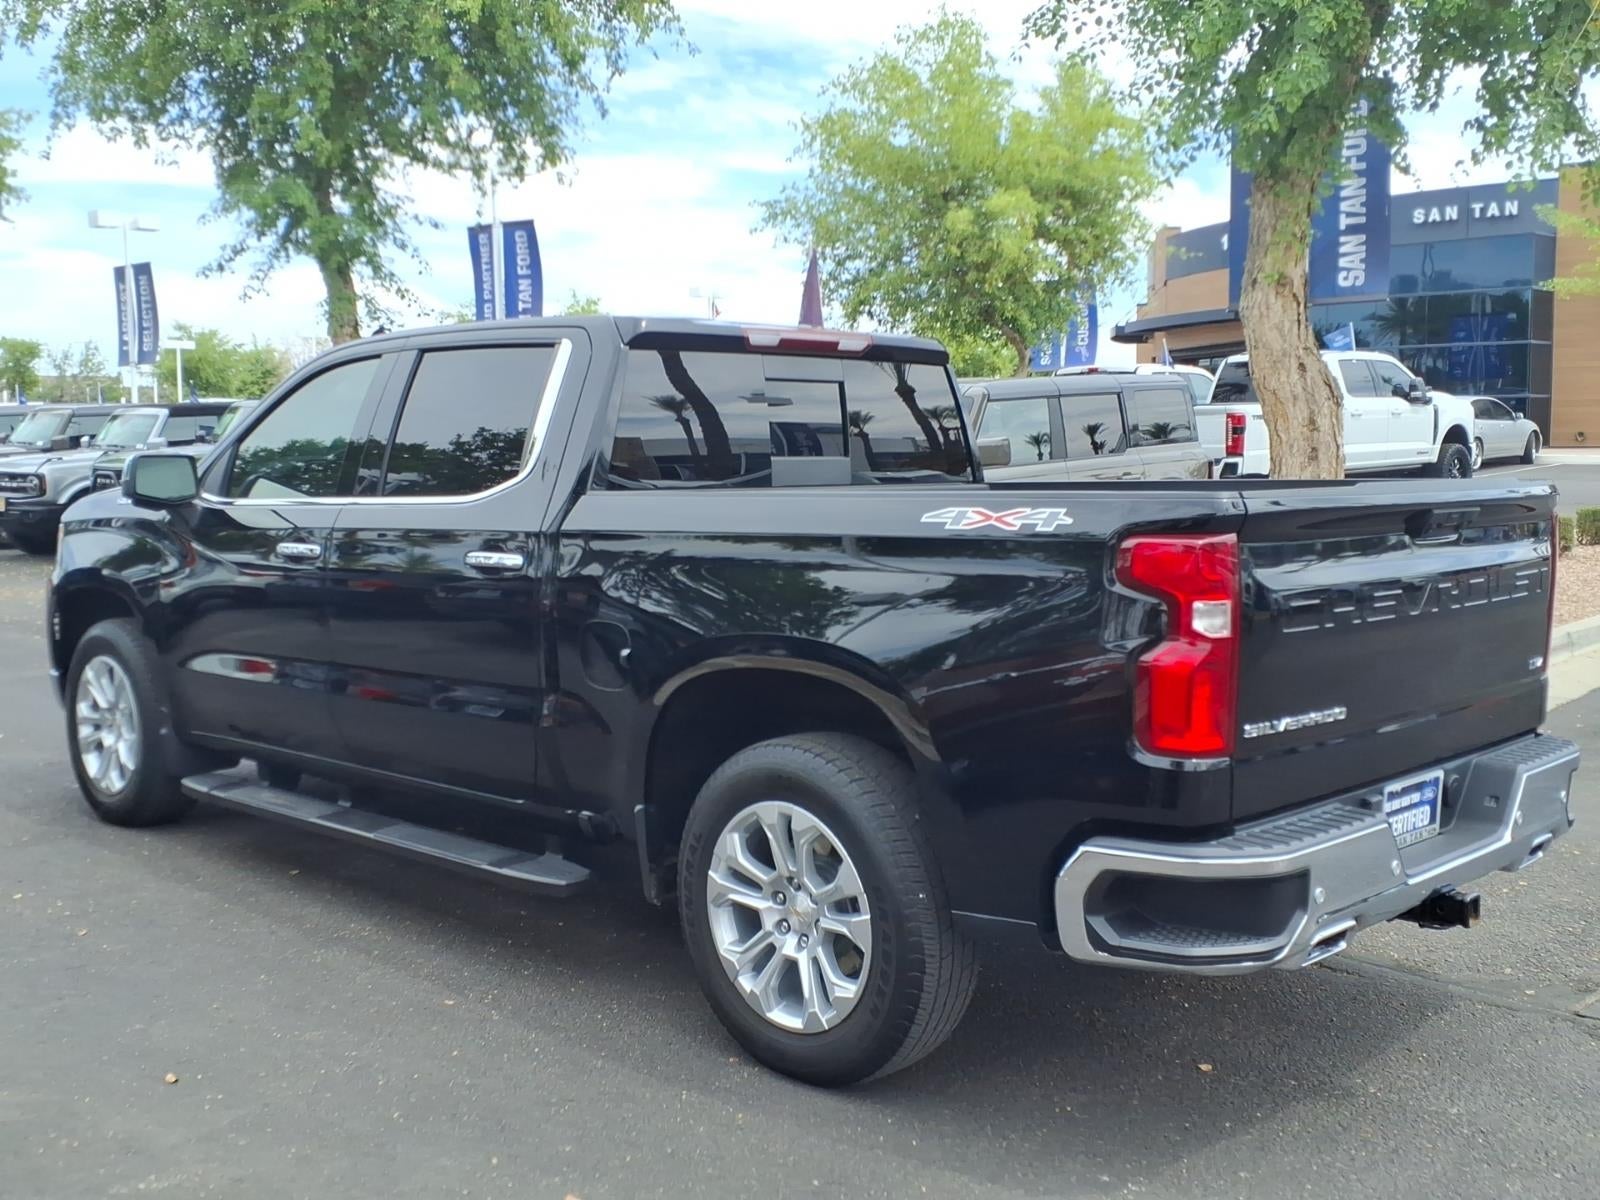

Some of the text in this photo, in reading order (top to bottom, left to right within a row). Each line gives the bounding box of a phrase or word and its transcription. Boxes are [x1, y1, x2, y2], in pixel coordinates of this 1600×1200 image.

[1339, 177, 1367, 231] TAN
[1413, 200, 1519, 225] SAN TAN
[478, 233, 492, 300] PARTNER
[515, 230, 531, 275] FORD
[1338, 234, 1367, 287] SAN
[138, 275, 153, 352] SELECTION
[518, 279, 532, 312] TAN
[1282, 567, 1549, 633] CHEVROLET
[1243, 707, 1347, 738] SILVERADO
